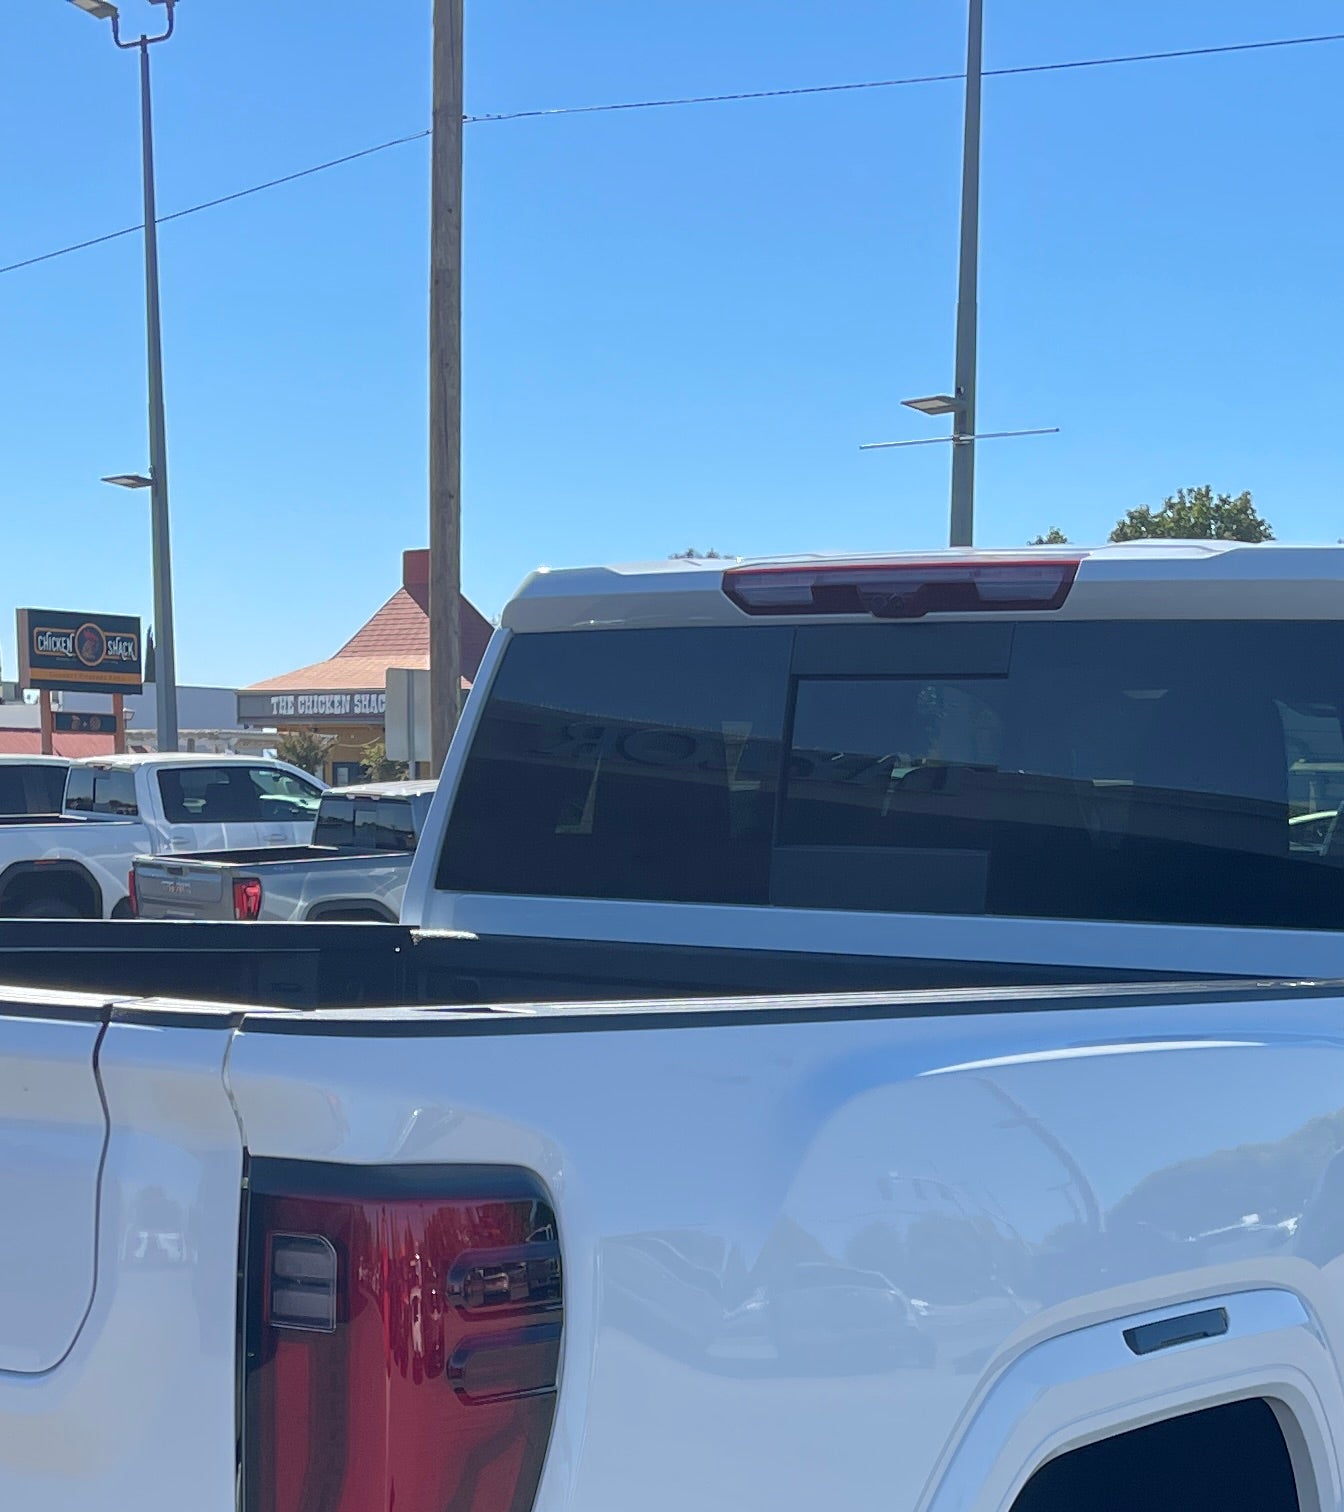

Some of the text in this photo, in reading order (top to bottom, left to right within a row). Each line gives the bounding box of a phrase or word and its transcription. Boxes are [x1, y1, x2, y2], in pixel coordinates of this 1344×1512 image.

[38, 632, 137, 660] CHICKEN SHACK
[271, 693, 386, 715] THE CHICKEN SHAC
